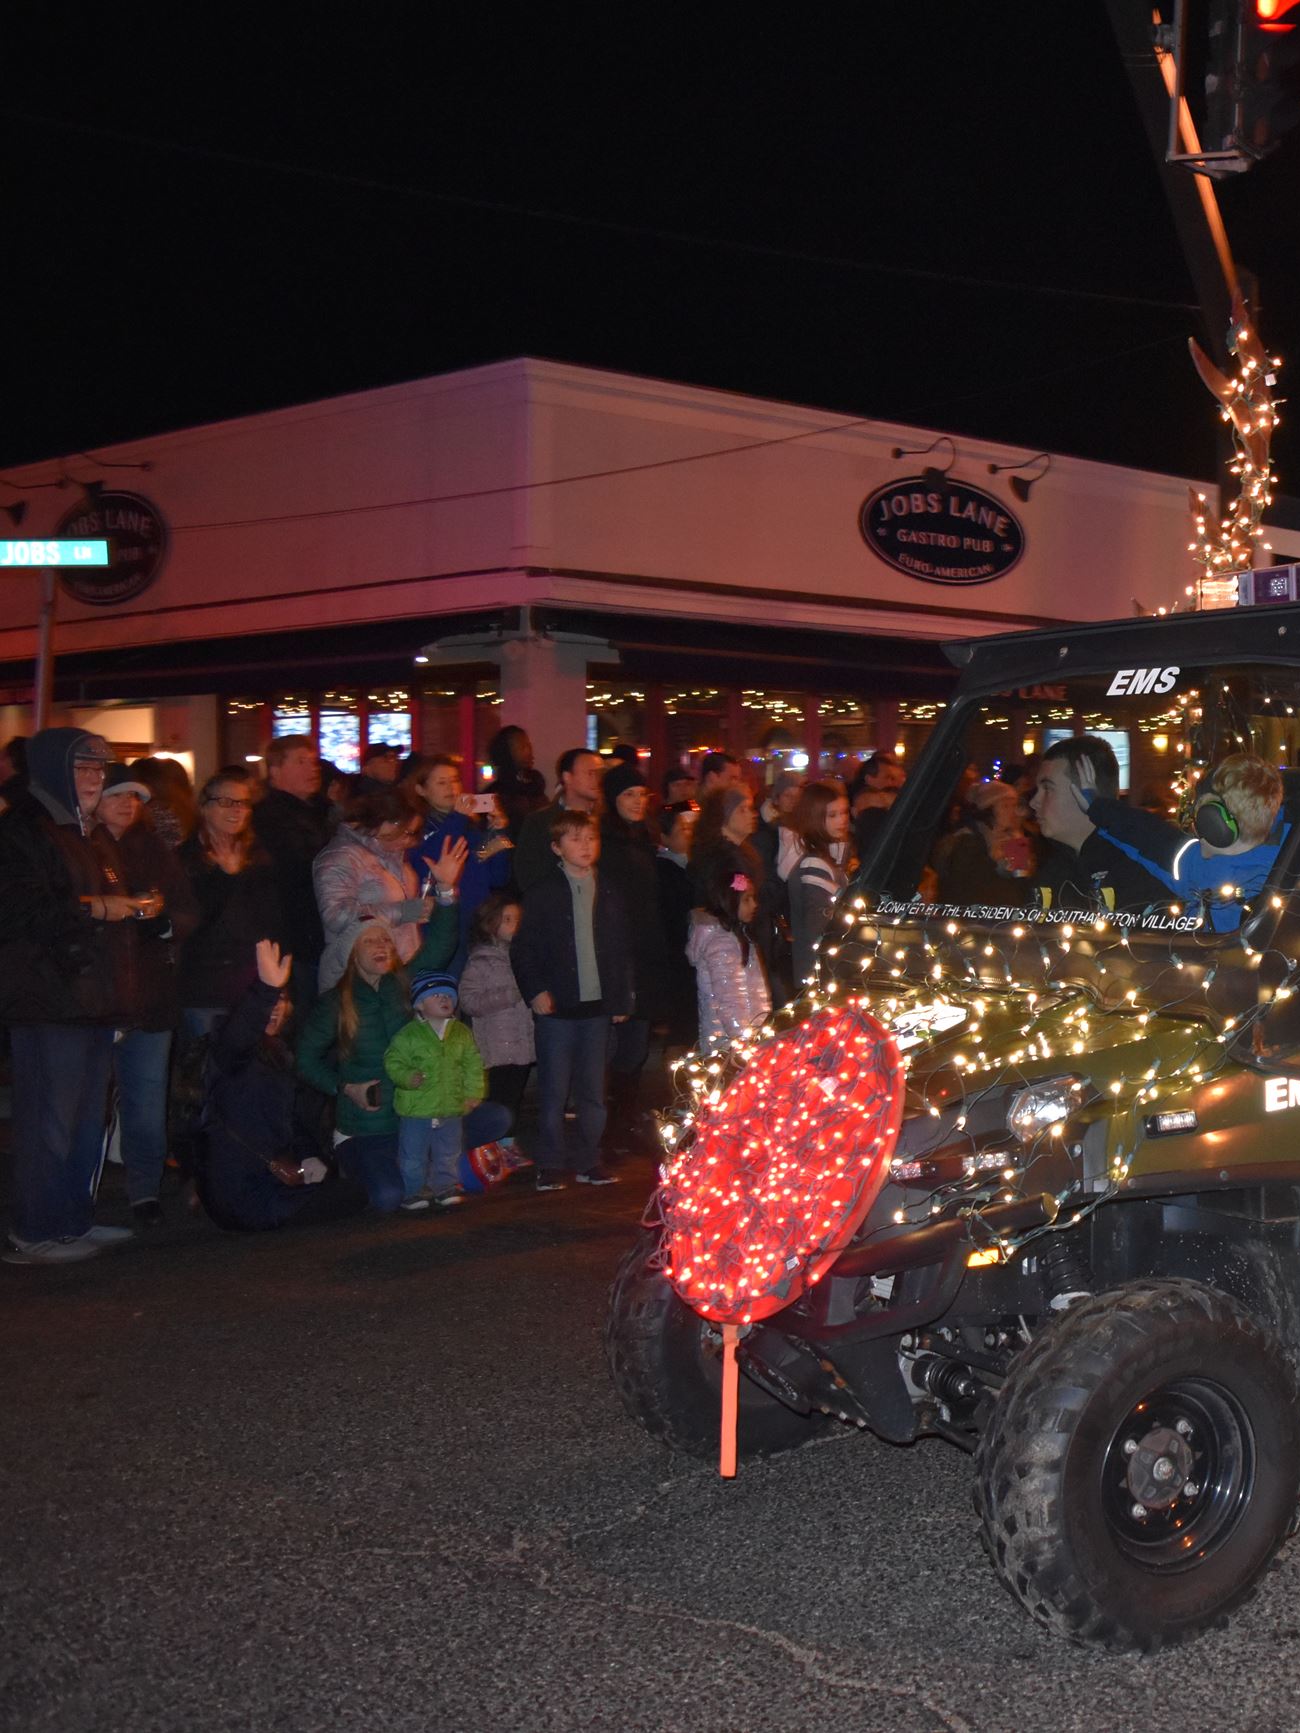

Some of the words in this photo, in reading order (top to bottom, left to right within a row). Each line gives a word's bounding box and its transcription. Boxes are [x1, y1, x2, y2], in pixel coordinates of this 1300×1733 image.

[105, 509, 151, 538] LANE
[880, 493, 943, 521] JOBS
[950, 495, 1011, 537] LANE
[1, 541, 62, 565] JOBS
[896, 529, 961, 549] GASTRO
[963, 537, 995, 553] PUB
[1106, 666, 1180, 696] EMS
[941, 904, 961, 917] THE
[1141, 915, 1197, 931] VILLAGE
